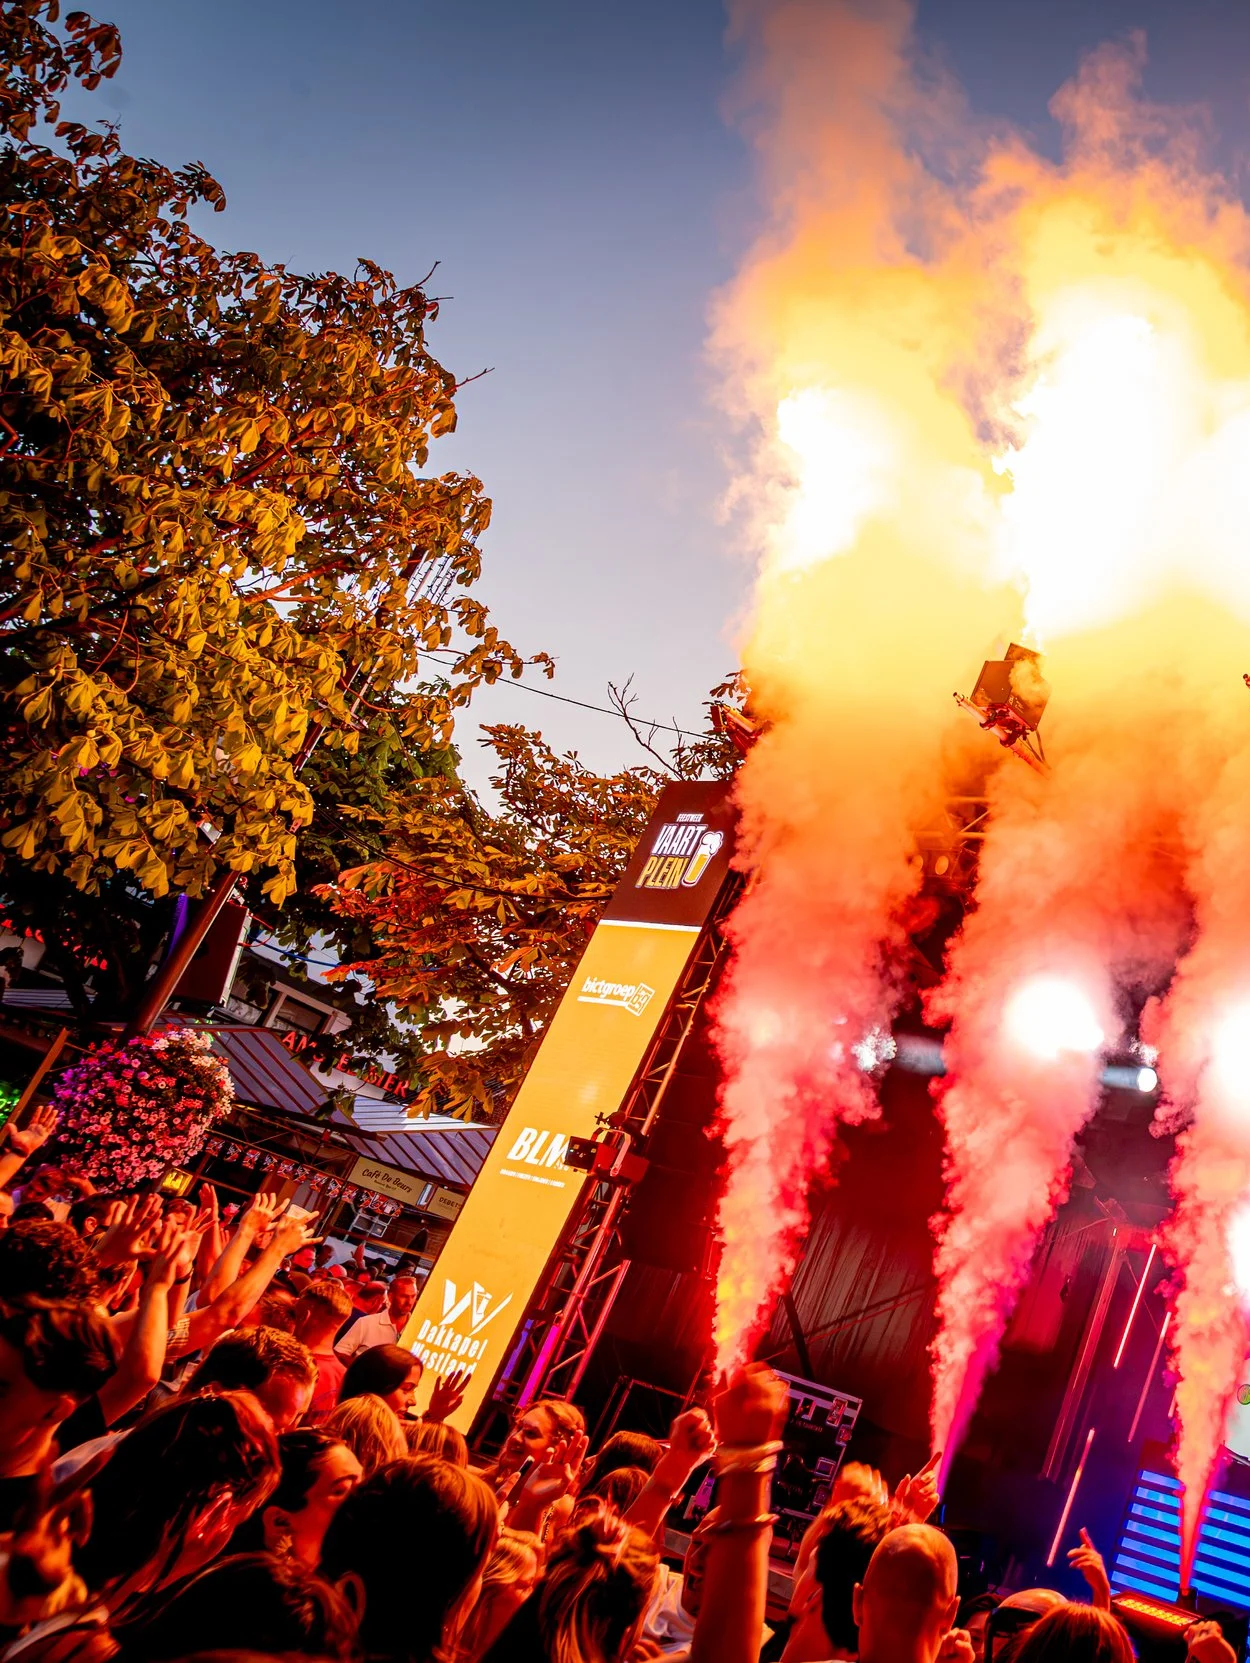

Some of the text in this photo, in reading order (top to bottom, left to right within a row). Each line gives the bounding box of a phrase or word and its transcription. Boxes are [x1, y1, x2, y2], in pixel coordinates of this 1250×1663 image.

[651, 823, 709, 856] VAART
[637, 856, 690, 888] PLEIN
[581, 975, 637, 1001] bictgroep
[506, 1126, 570, 1168] BLM
[361, 1168, 381, 1180] Café
[381, 1172, 393, 1183] De
[392, 1177, 413, 1194] Beurs
[417, 1318, 488, 1361] Dakkapel
